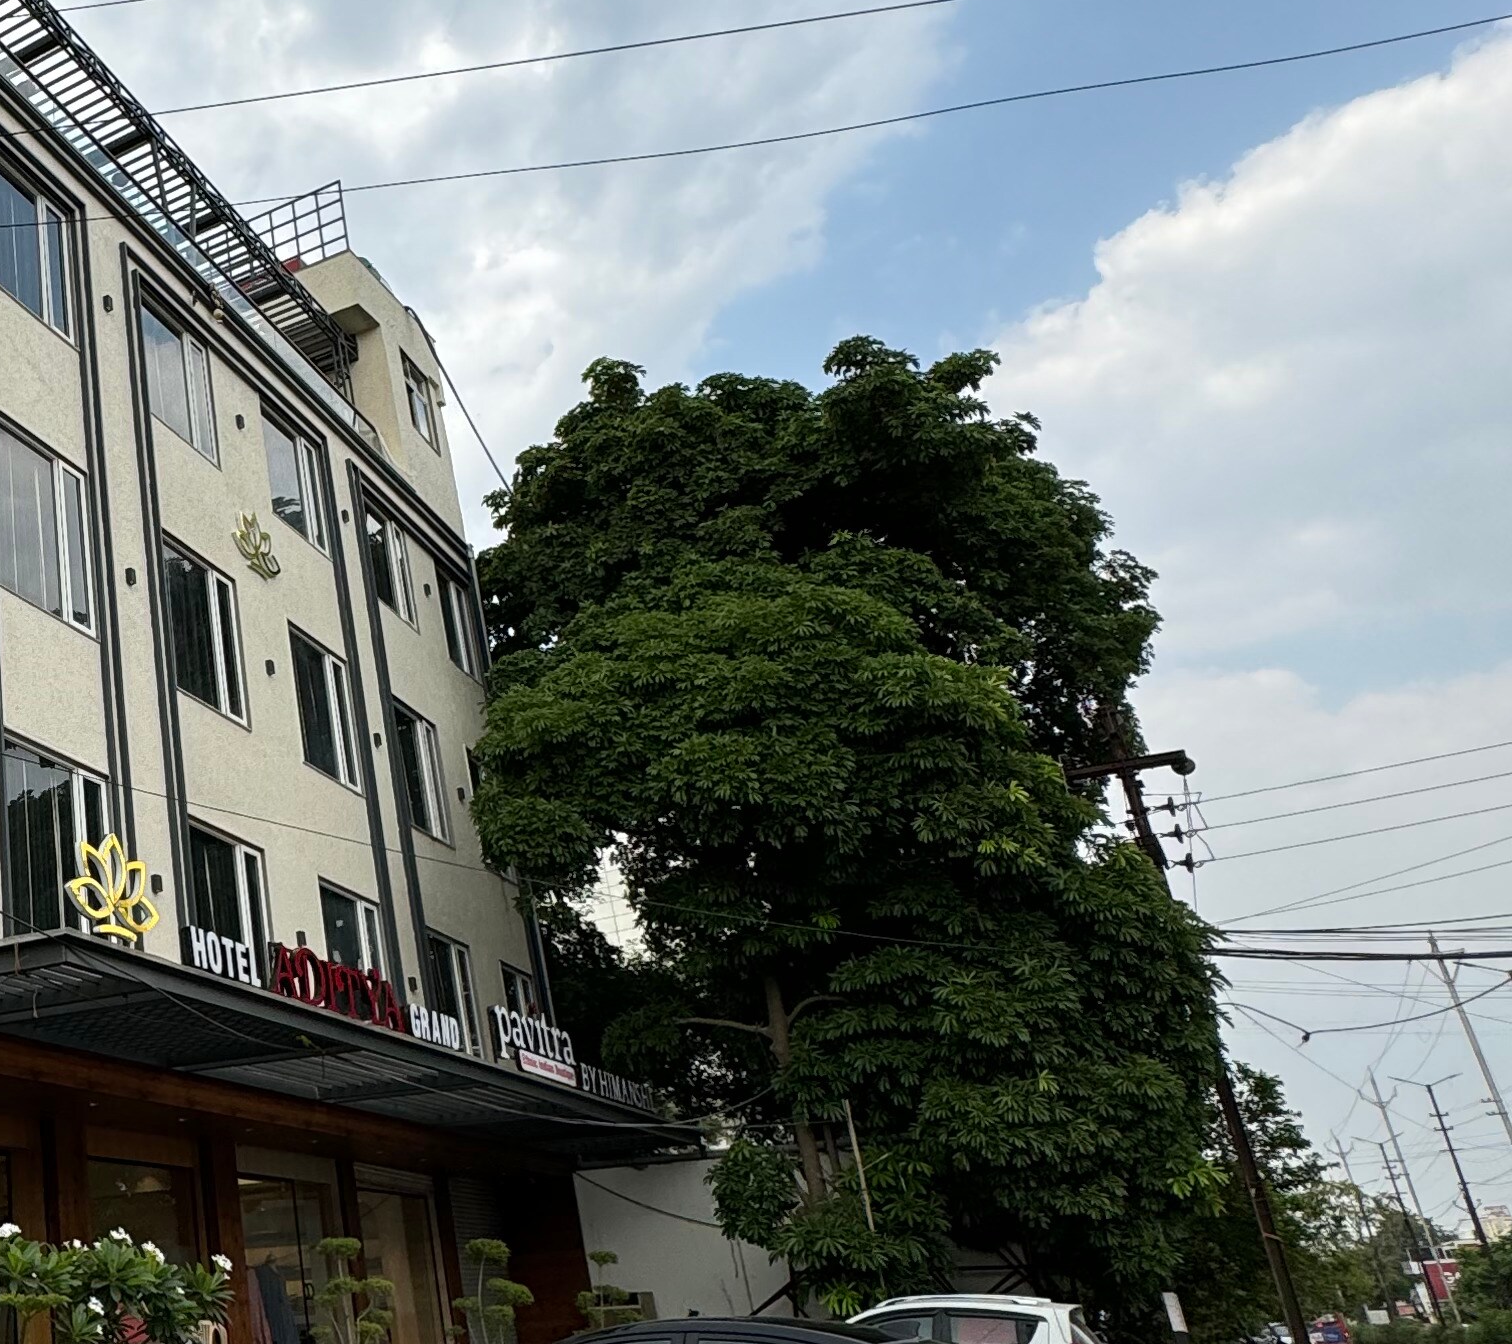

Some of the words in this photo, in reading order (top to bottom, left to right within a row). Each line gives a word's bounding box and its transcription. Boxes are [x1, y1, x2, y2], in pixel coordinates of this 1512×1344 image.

[190, 926, 261, 987] HOTEL
[270, 944, 405, 1033] ADITYA
[410, 1003, 459, 1050] GRAND
[494, 1005, 576, 1066] pavitra
[580, 1063, 597, 1093] BY
